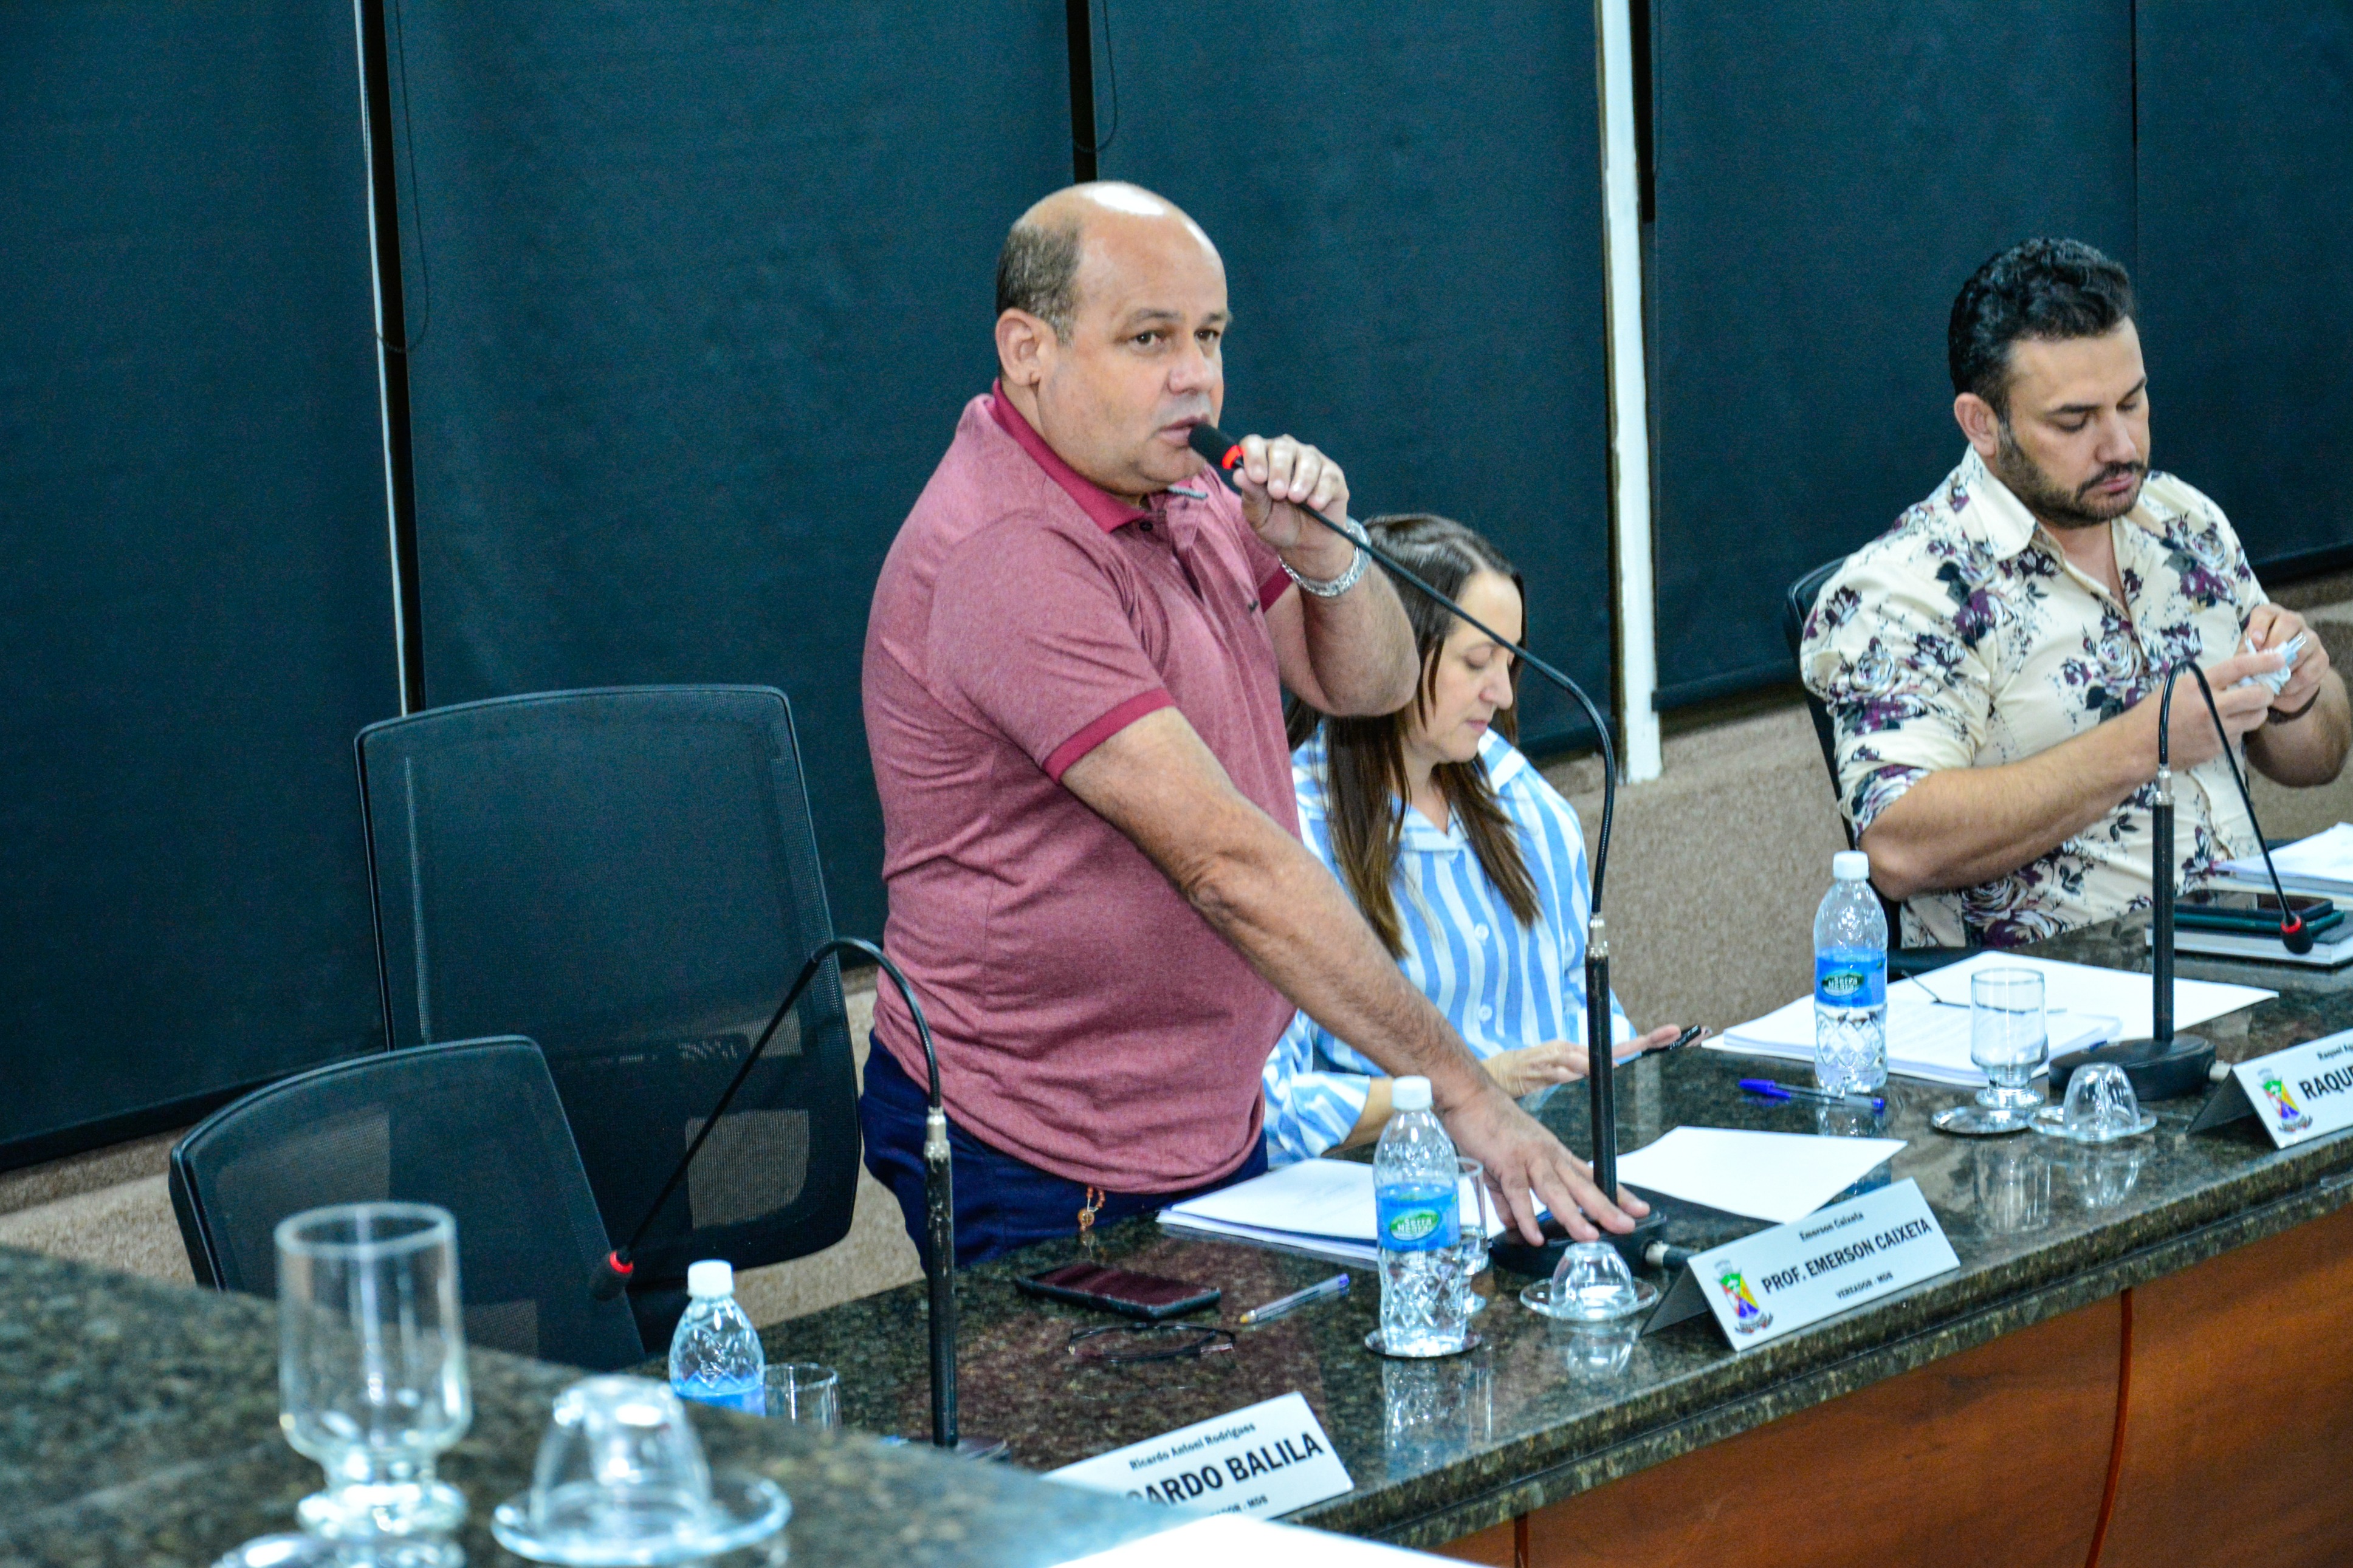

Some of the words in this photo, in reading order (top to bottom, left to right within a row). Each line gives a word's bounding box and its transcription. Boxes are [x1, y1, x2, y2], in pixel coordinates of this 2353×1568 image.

[1404, 1217, 1432, 1227] Serra
[1799, 1222, 1834, 1242] Emerson
[1834, 1211, 1864, 1228] Caixeta
[1761, 1265, 1806, 1295] PROF.
[1805, 1238, 1875, 1277] EMERSON
[1875, 1217, 1932, 1250] CAIXETA
[1129, 1451, 1170, 1471] Ricardo
[1204, 1423, 1256, 1445] Rodrigues
[1225, 1432, 1325, 1484] BALILA
